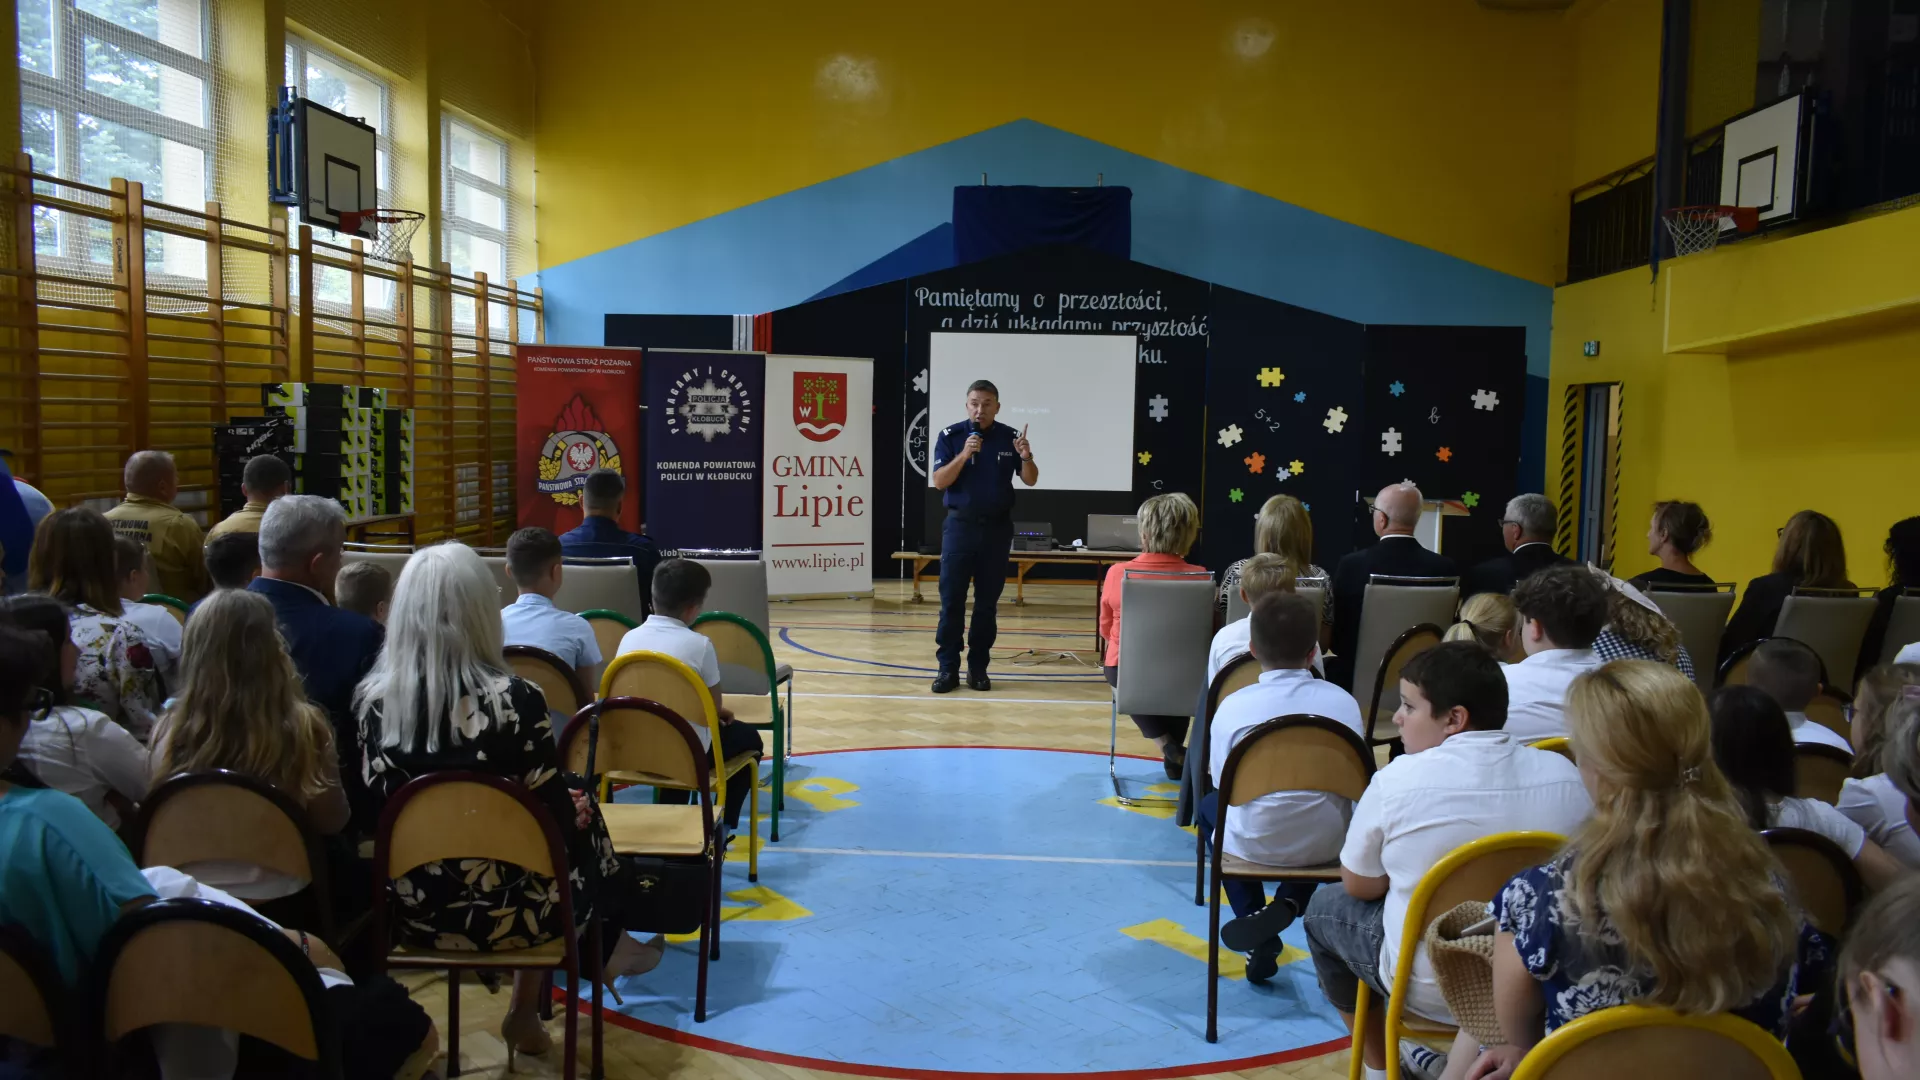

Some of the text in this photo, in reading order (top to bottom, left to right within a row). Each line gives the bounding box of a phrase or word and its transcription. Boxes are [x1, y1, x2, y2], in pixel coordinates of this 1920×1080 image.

[914, 287, 1168, 315] Pamiętamy o przeszłości,
[527, 355, 632, 367] PAŃSTWOWA STRAŻ POŻARNA
[665, 365, 752, 434] POMAGAMY I CHRONIMY
[692, 395, 726, 403] POLICJA
[799, 406, 812, 418] W
[913, 437, 922, 448] 9
[917, 450, 926, 462] 8
[656, 461, 757, 470] KOMENDA POWIATOWA
[772, 455, 865, 477] GMINA
[660, 472, 753, 481] POLICJI W KŁOBUCKU
[538, 480, 573, 492] PAŃSTWOWA
[772, 484, 864, 528] Lipie
[771, 552, 865, 572] www.lipie.pl
